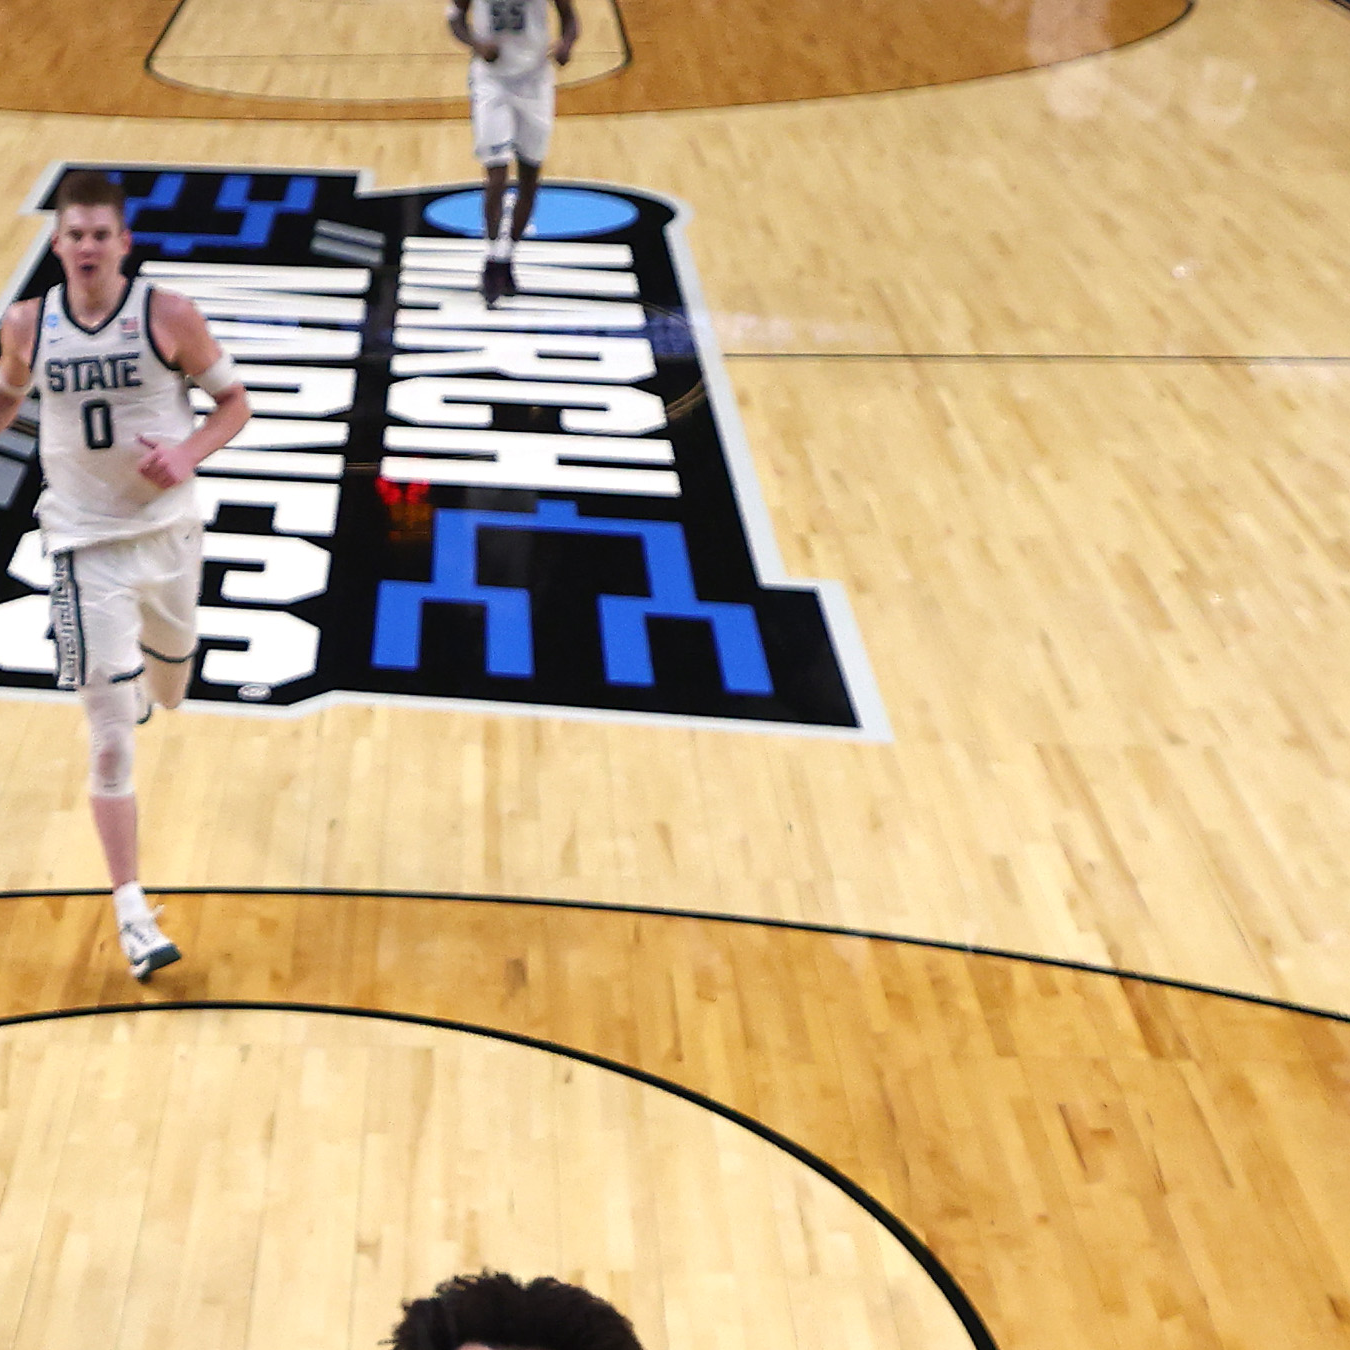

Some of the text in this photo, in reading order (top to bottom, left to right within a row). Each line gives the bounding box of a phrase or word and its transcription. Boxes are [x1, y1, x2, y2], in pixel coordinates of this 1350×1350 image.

[44, 351, 143, 393] STATE
[379, 235, 683, 498] MARCH
[81, 399, 114, 450] 0
